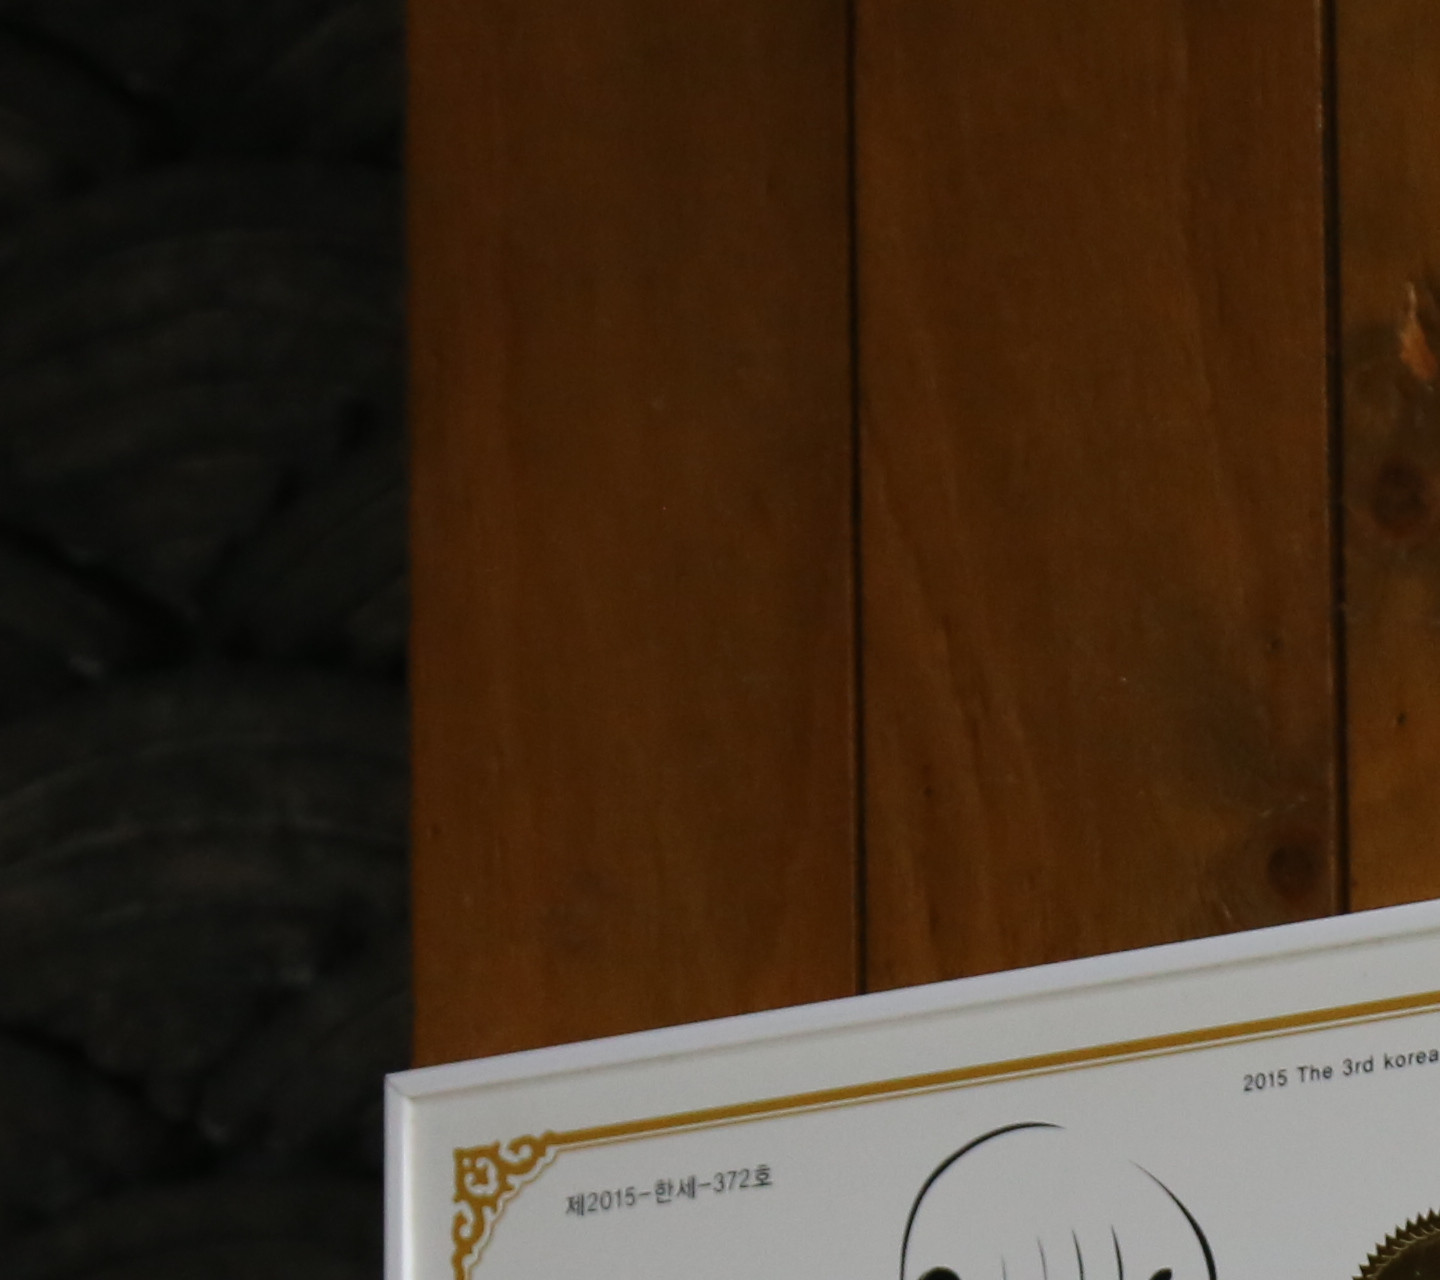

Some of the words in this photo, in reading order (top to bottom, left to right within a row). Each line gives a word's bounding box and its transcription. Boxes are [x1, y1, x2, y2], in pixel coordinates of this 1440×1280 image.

[1243, 1068, 1288, 1092] 2015
[1296, 1065, 1333, 1083] The
[1342, 1055, 1374, 1077] 3rd
[1383, 1049, 1440, 1070] korea
[566, 1164, 773, 1217] 제2015-한세-372호
